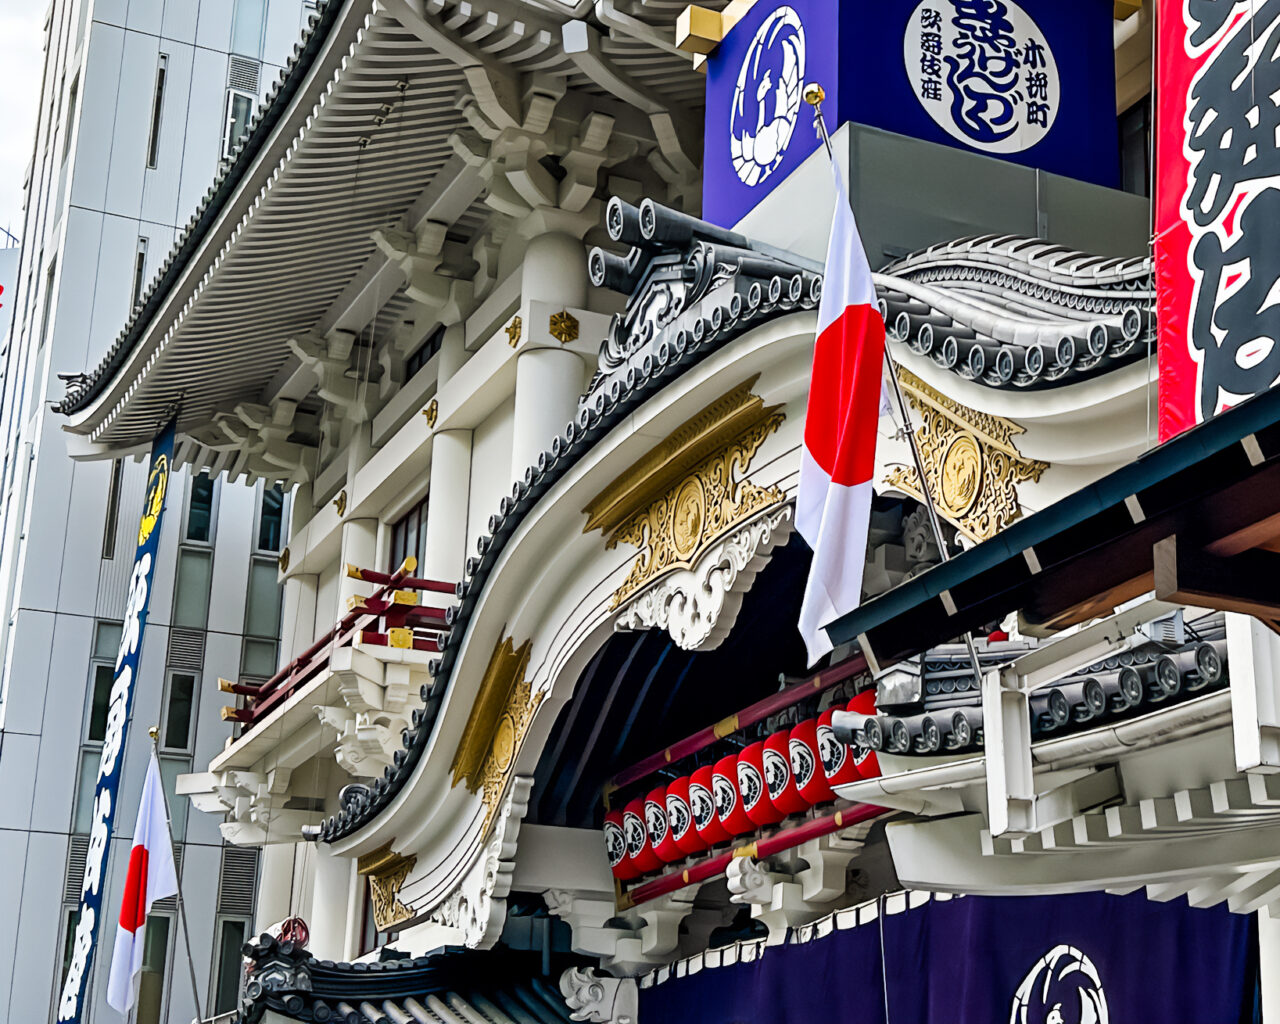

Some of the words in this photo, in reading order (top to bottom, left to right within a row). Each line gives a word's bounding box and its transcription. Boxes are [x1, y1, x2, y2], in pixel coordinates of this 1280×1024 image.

[919, 7, 943, 103] 歌舞伎座
[1022, 38, 1051, 129] 木挽町
